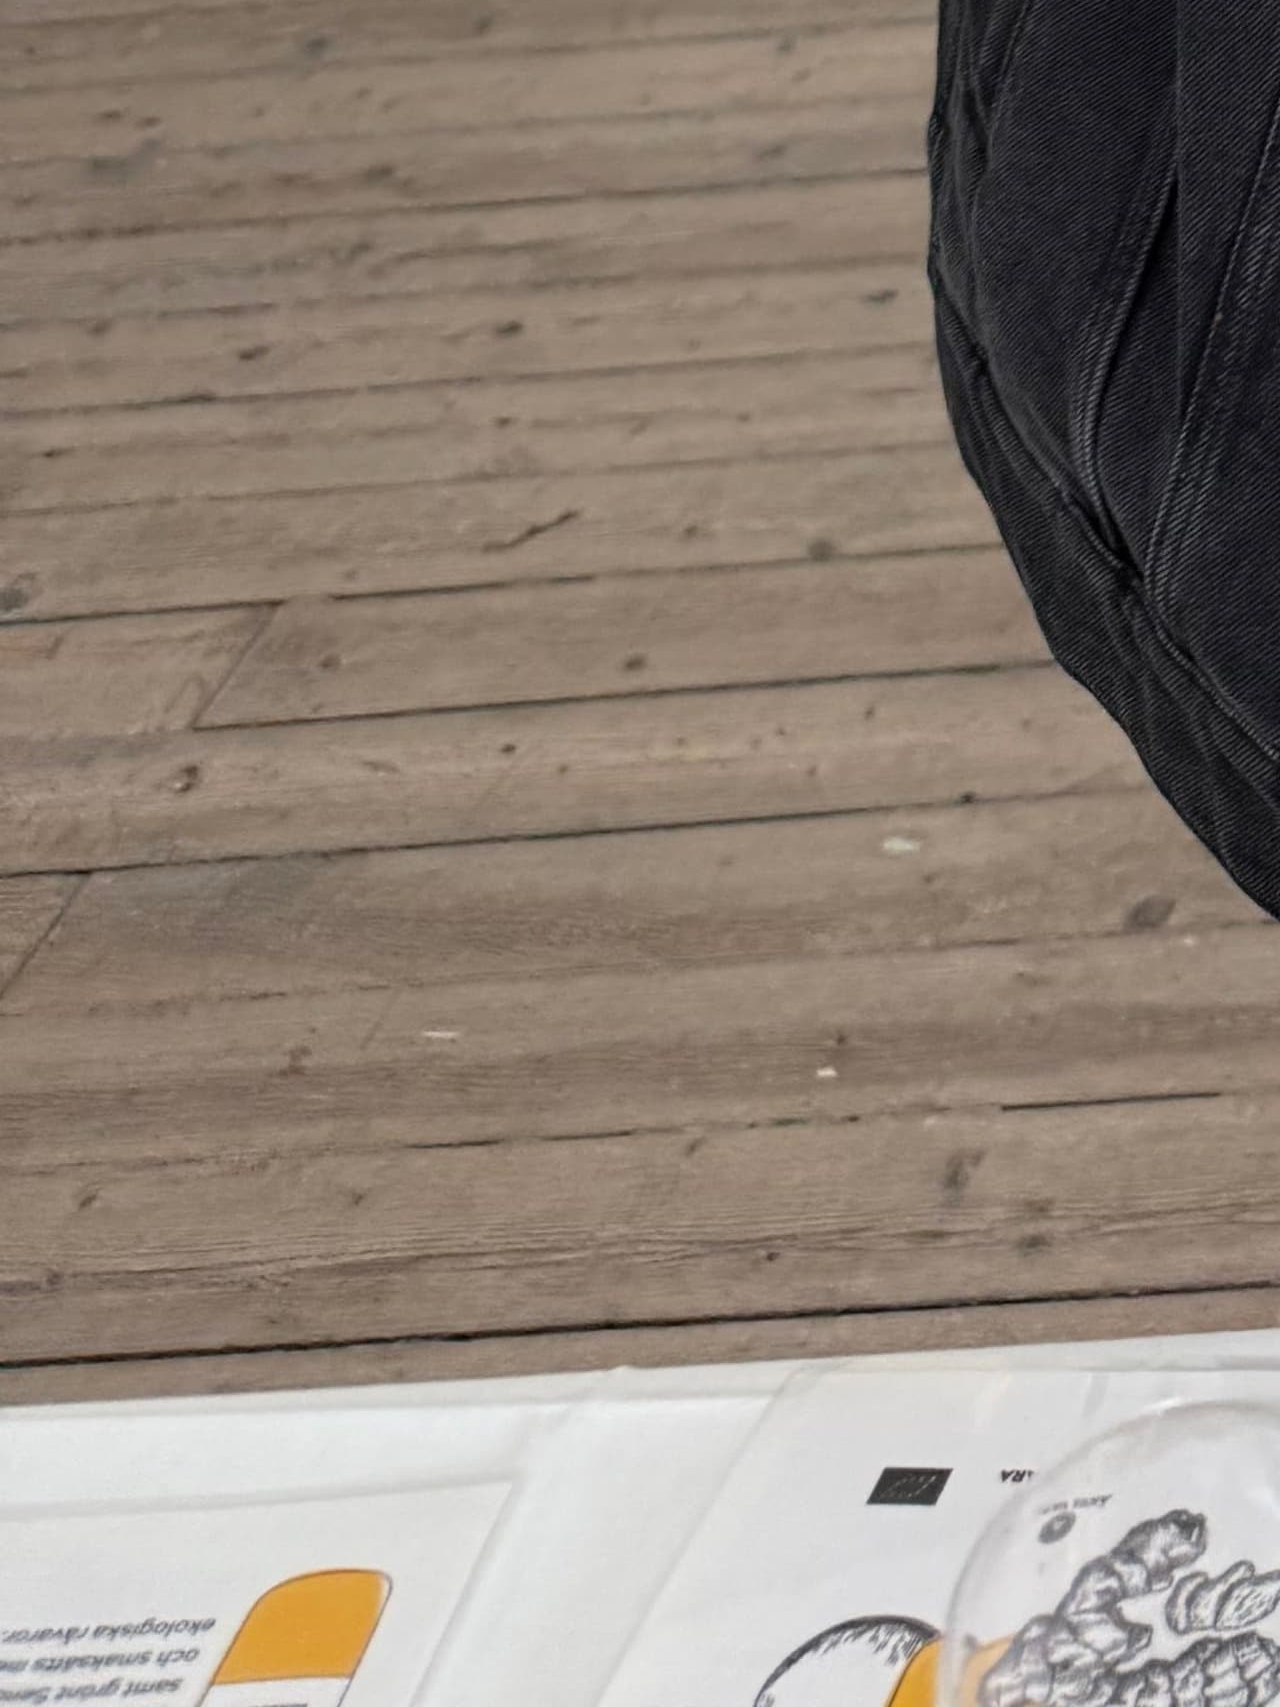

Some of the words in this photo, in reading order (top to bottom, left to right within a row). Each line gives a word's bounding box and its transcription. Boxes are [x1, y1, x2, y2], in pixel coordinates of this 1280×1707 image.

[93, 1617, 216, 1641] ekologiska
[31, 1650, 153, 1671] smaksätts
[157, 1648, 201, 1667] och
